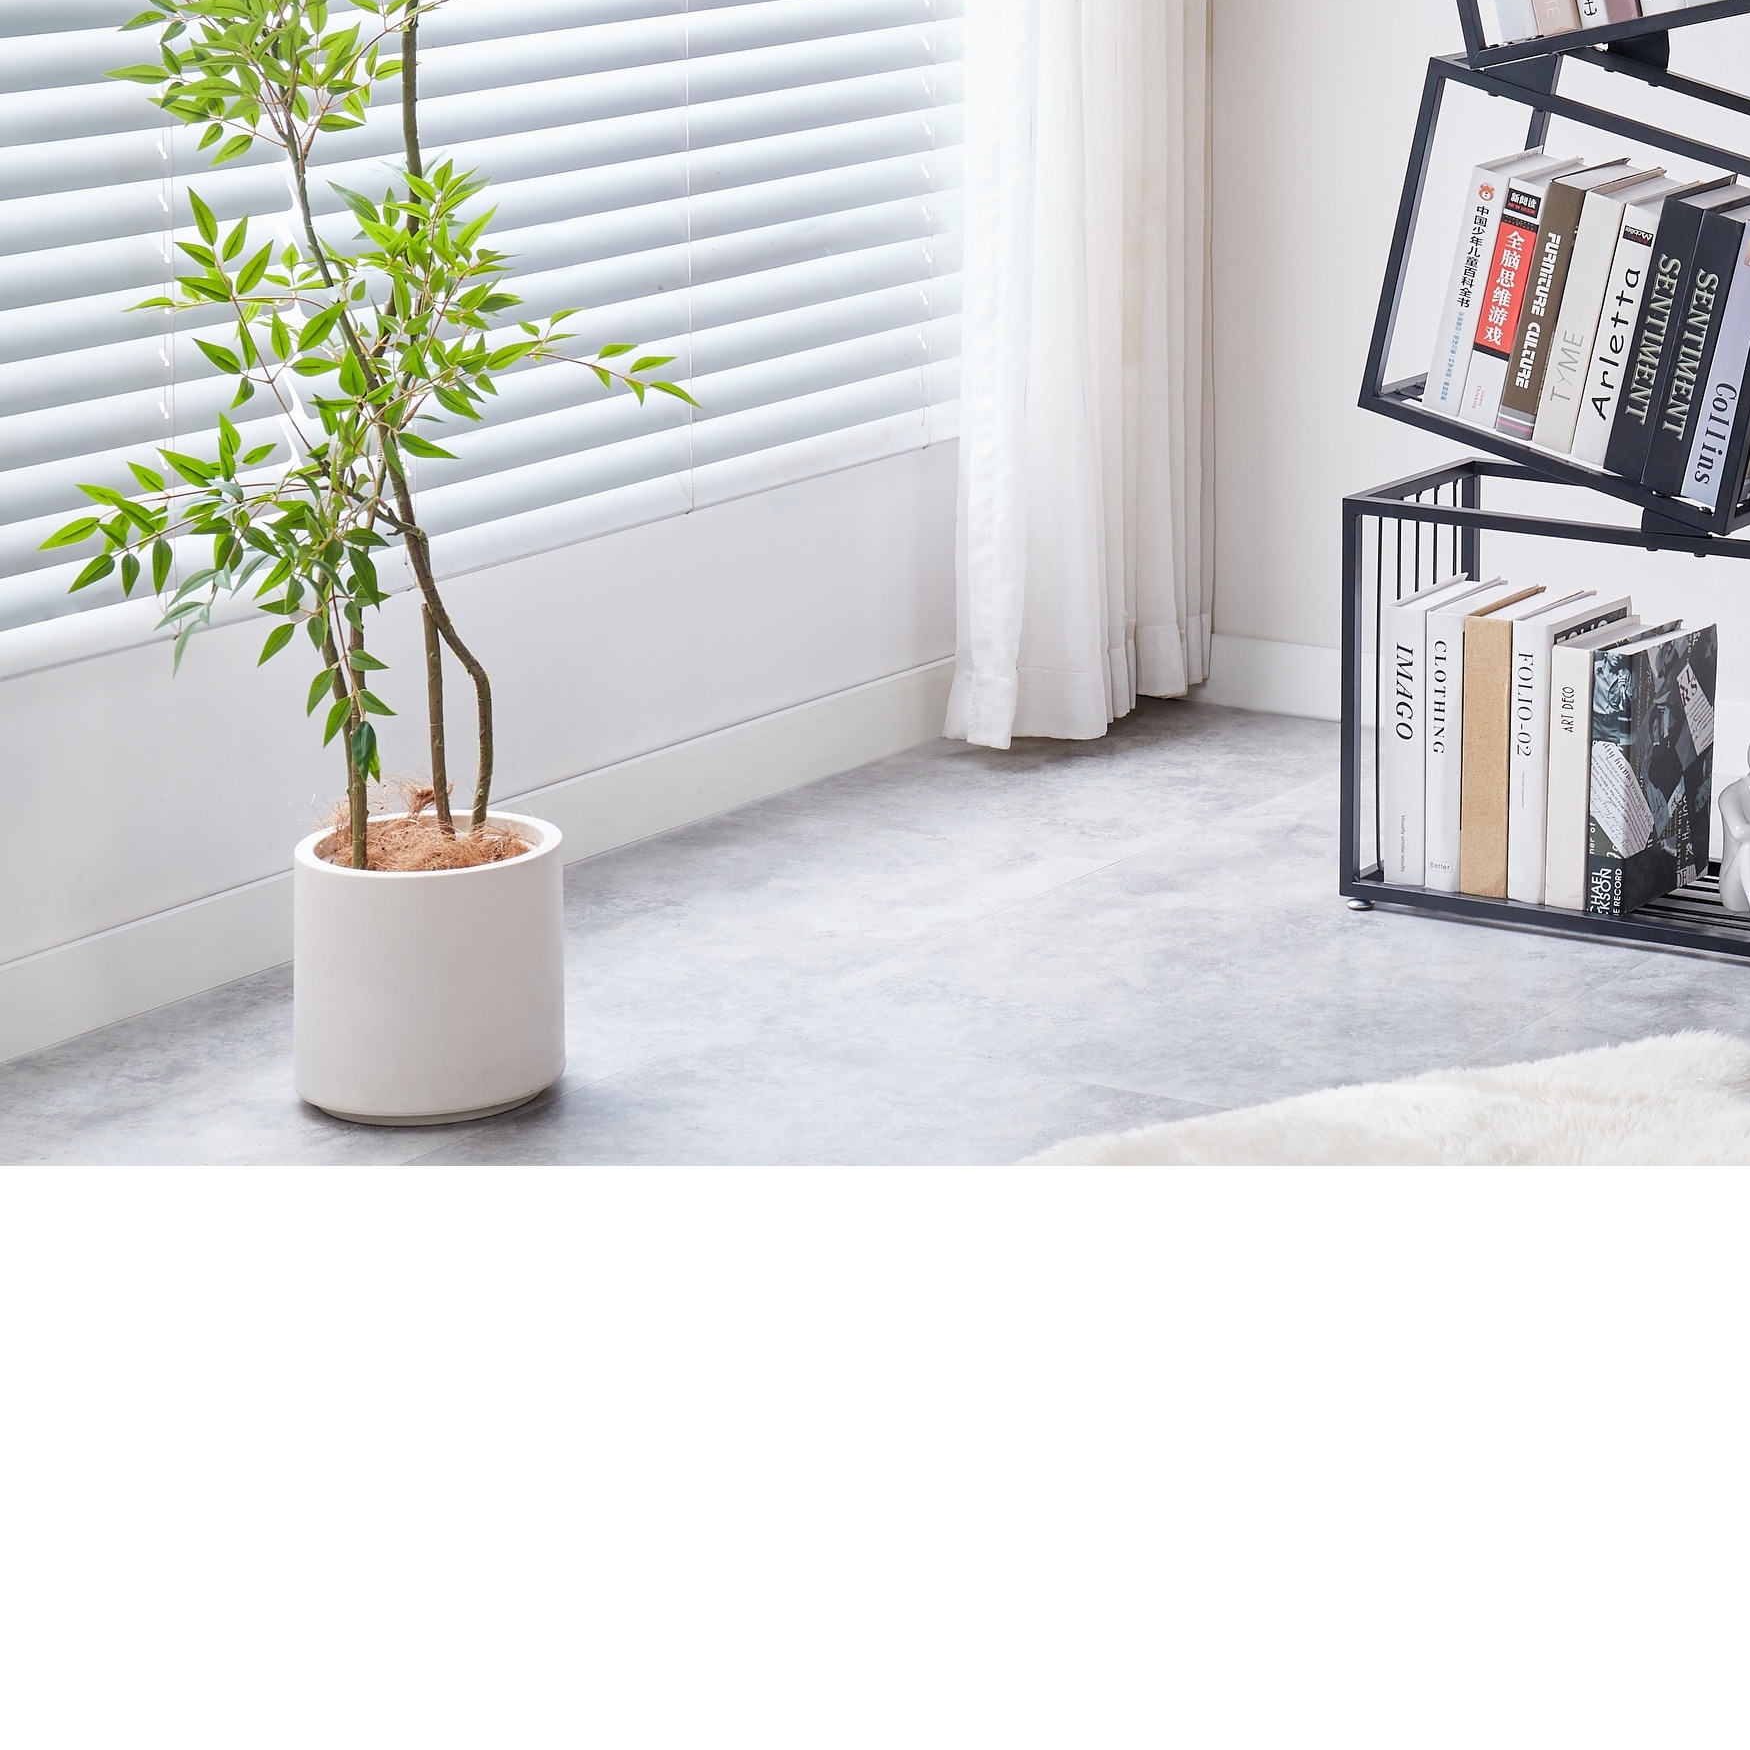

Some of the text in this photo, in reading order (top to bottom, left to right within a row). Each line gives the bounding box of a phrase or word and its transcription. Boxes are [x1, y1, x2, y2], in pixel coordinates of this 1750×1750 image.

[1457, 205, 1490, 309] 中国少年儿童百科全书
[1483, 230, 1526, 346] 全脑思维游戏
[1549, 330, 1584, 402] TYME
[1591, 268, 1641, 421] Arletta
[1625, 253, 1682, 426] SENTIMENT
[1662, 269, 1720, 442] SENTIMENT
[1694, 383, 1738, 485] Collins
[1395, 642, 1414, 741] IMAGO
[1433, 640, 1448, 754] CLOTHING
[1516, 652, 1534, 757] FOLIO-02
[1561, 686, 1575, 733] ART DECO
[1429, 861, 1450, 871] Better
[1613, 867, 1623, 908] RECORD
